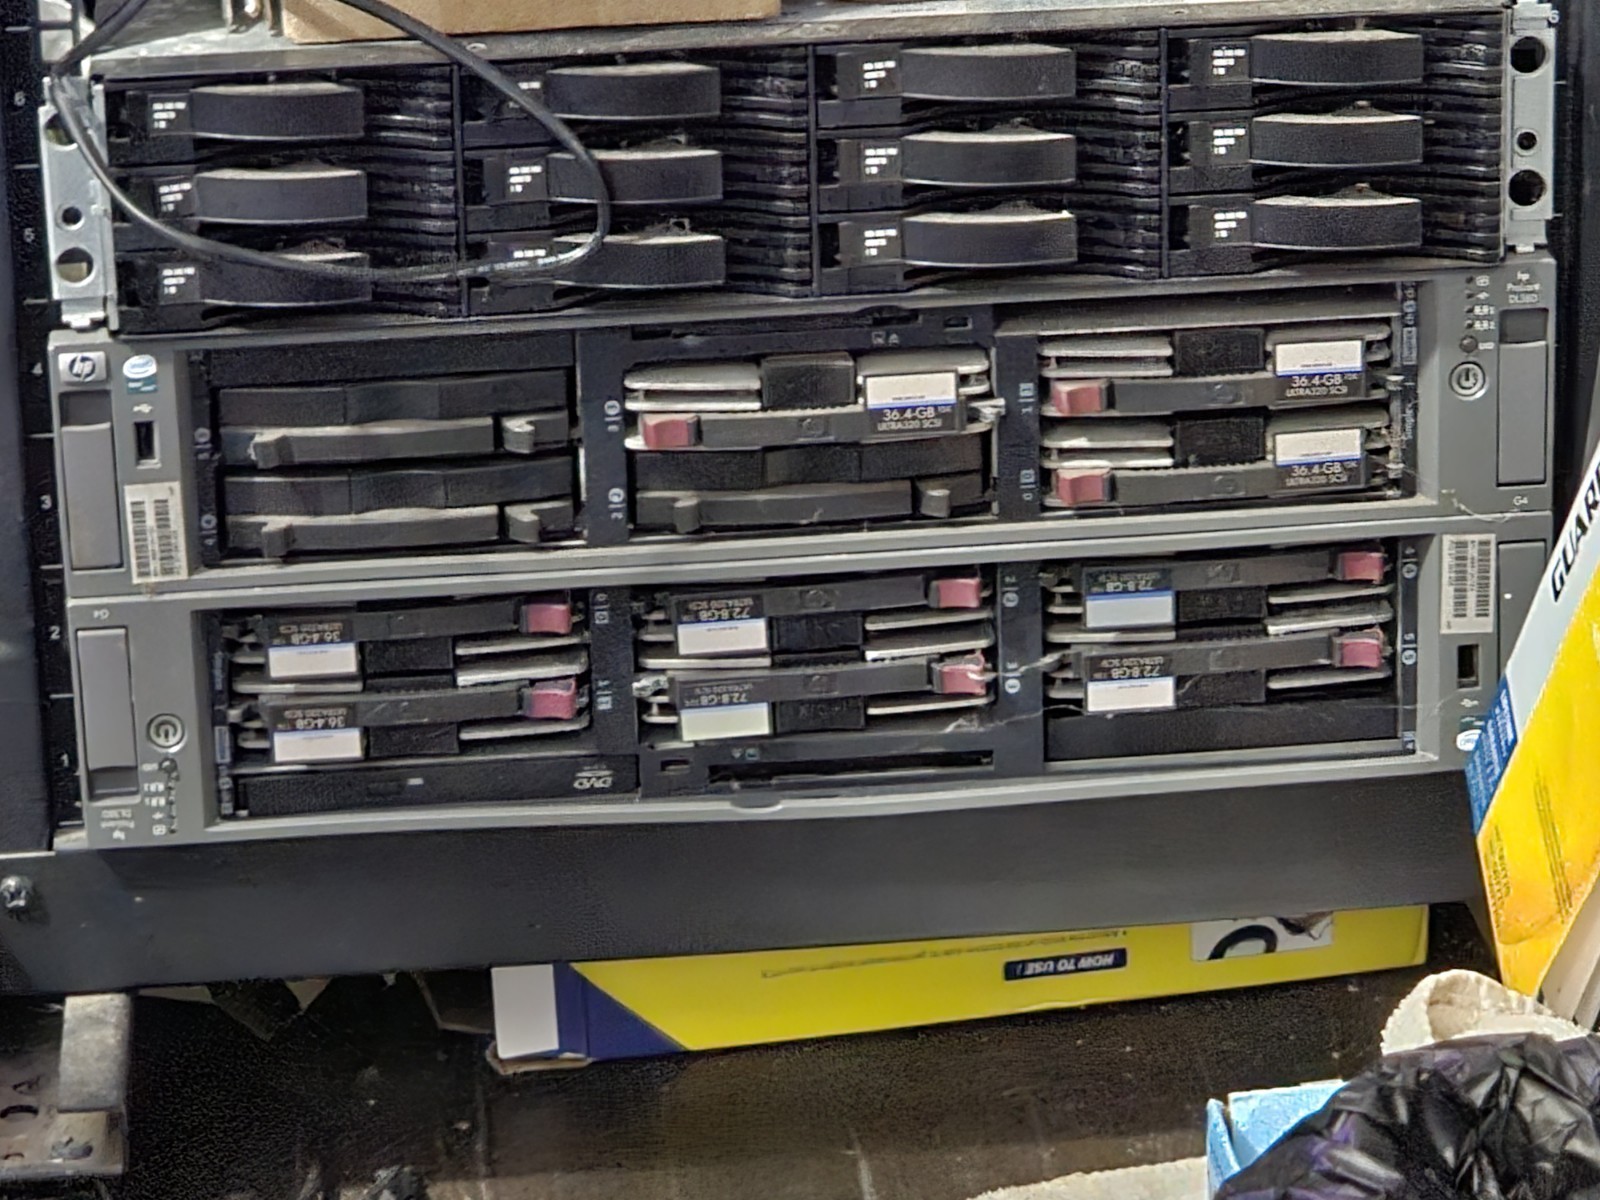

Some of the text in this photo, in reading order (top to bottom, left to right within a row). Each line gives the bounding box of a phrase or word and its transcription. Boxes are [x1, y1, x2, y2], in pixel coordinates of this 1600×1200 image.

[1292, 373, 1343, 387] 36.4-GB
[883, 406, 936, 421] 36.4-GB
[1291, 462, 1342, 477] 36.4-GB
[40, 494, 52, 510] 3
[699, 608, 750, 620] 72.8-GB
[50, 625, 60, 640] 2
[291, 632, 341, 645] 36.4-GB
[1111, 665, 1160, 678] 72.8-GB
[699, 692, 747, 705] 72.8-GB
[295, 716, 345, 729] 36.4-GB
[61, 753, 69, 768] 1
[573, 776, 613, 789] DVD
[1025, 953, 1115, 976] HOW TO USE
